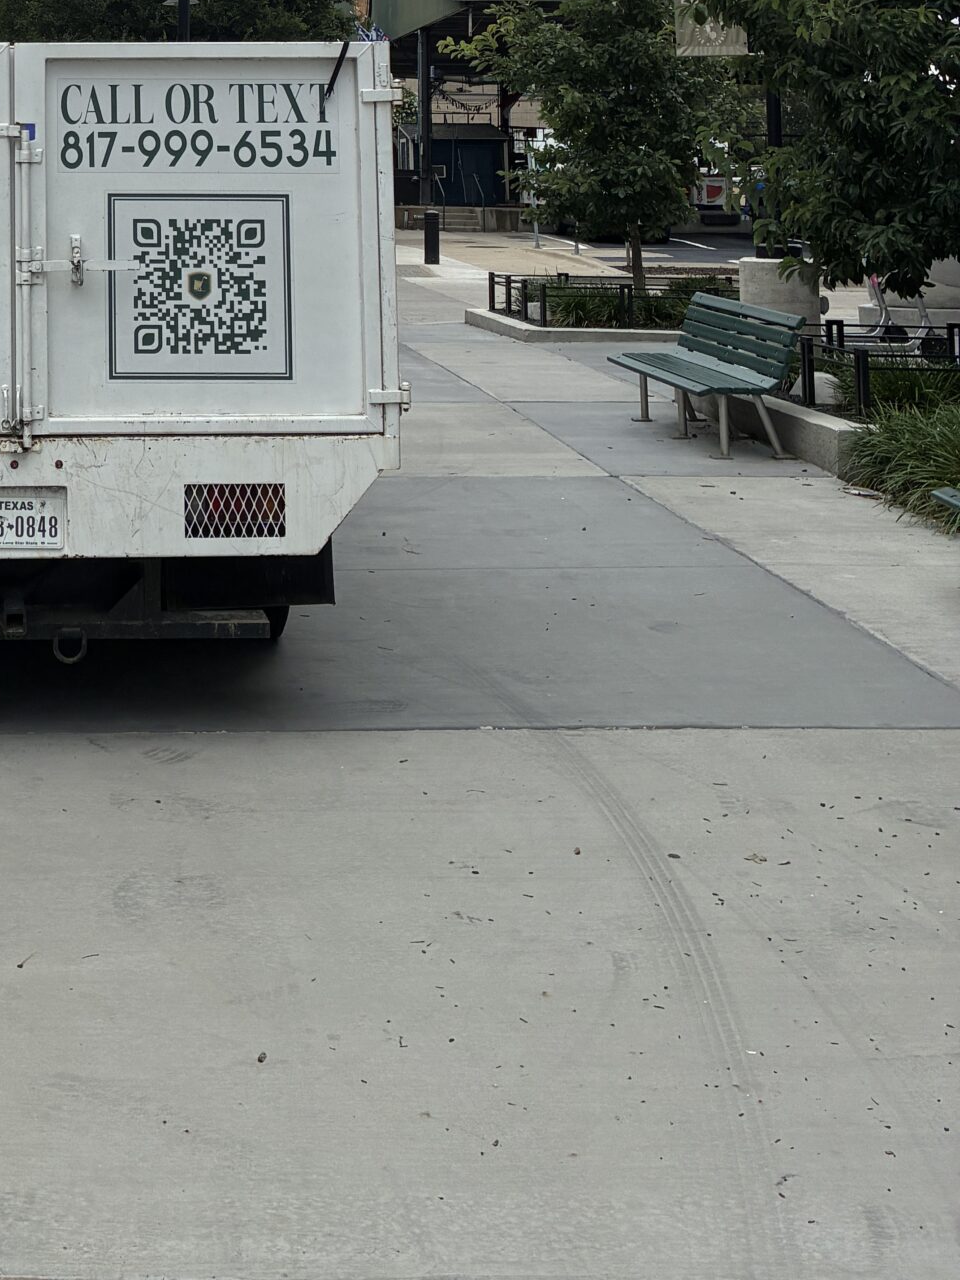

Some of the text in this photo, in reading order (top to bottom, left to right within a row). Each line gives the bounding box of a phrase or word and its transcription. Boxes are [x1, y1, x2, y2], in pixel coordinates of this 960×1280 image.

[60, 82, 331, 124] CALL OR TEXT
[60, 129, 337, 169] 817-999-6534
